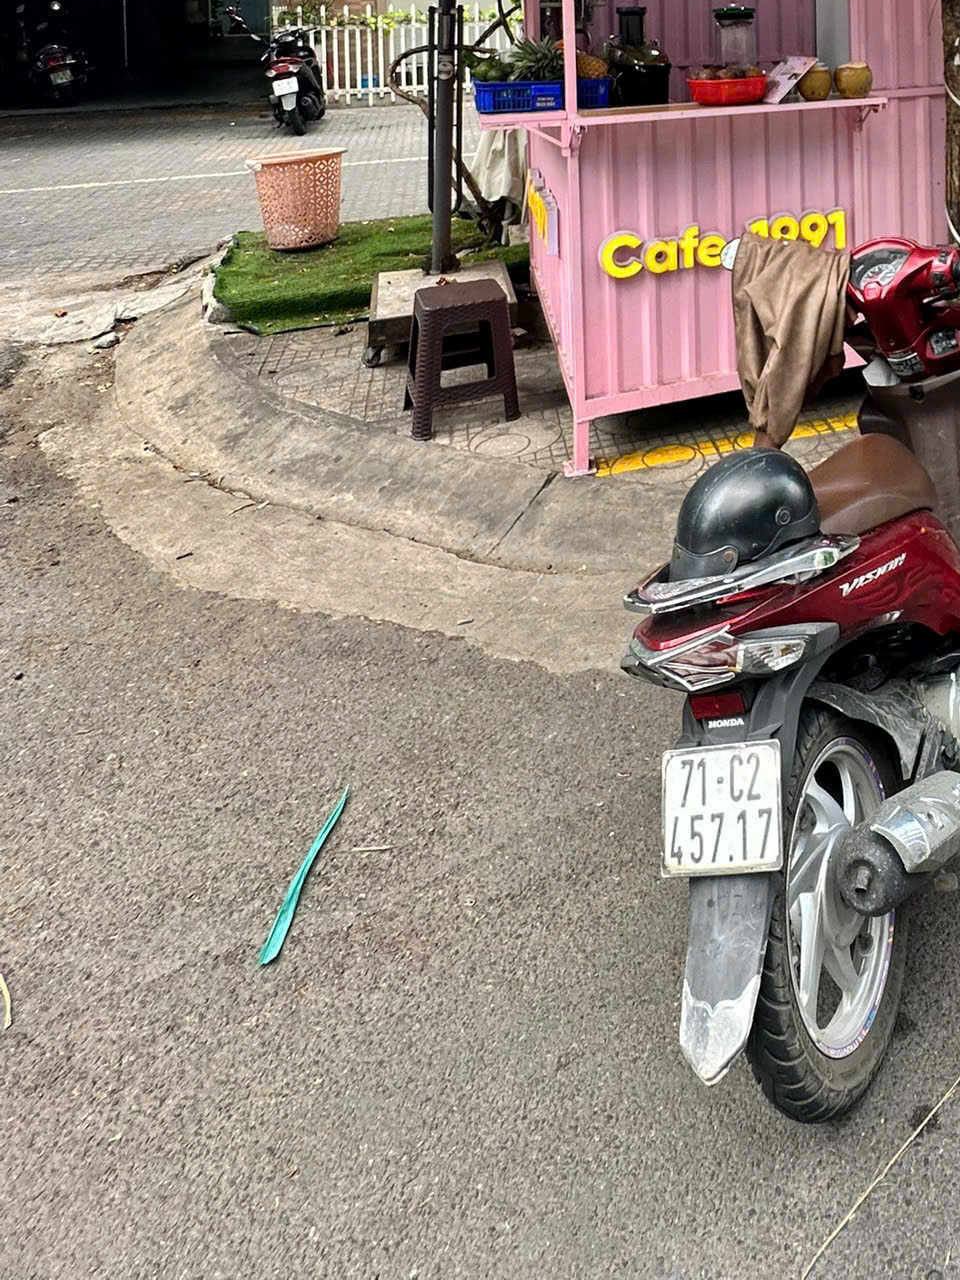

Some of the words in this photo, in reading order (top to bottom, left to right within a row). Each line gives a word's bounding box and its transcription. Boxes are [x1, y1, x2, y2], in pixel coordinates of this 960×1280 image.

[600, 225, 728, 279] Cafe
[838, 552, 907, 598] VISION
[708, 717, 745, 729] HONDA
[670, 807, 772, 865] 457.17
